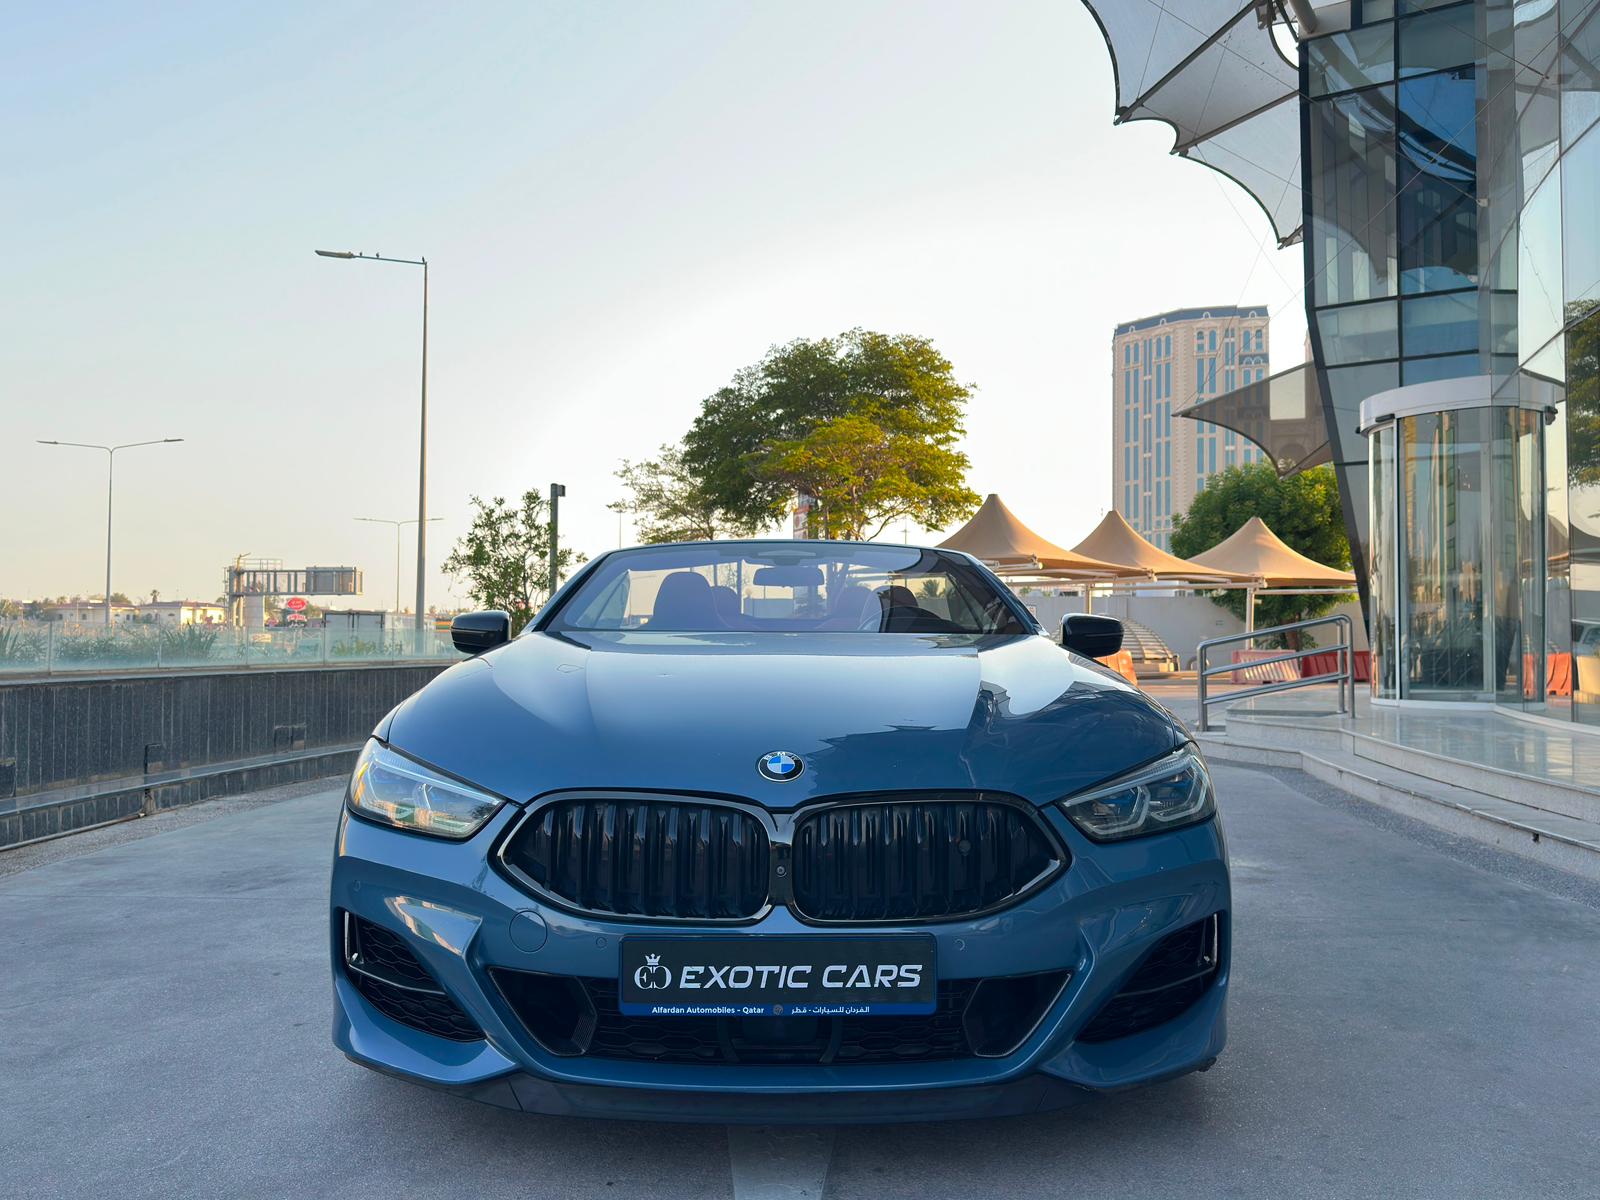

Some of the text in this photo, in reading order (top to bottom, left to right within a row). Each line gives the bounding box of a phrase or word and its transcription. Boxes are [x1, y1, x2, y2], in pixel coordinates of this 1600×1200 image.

[679, 964, 923, 989] EXOTIC CARS
[652, 1006, 685, 1014] Alfardan
[686, 1006, 736, 1014] Automobiles
[742, 1006, 765, 1015] Qatar
[791, 1006, 807, 1015] قطر
